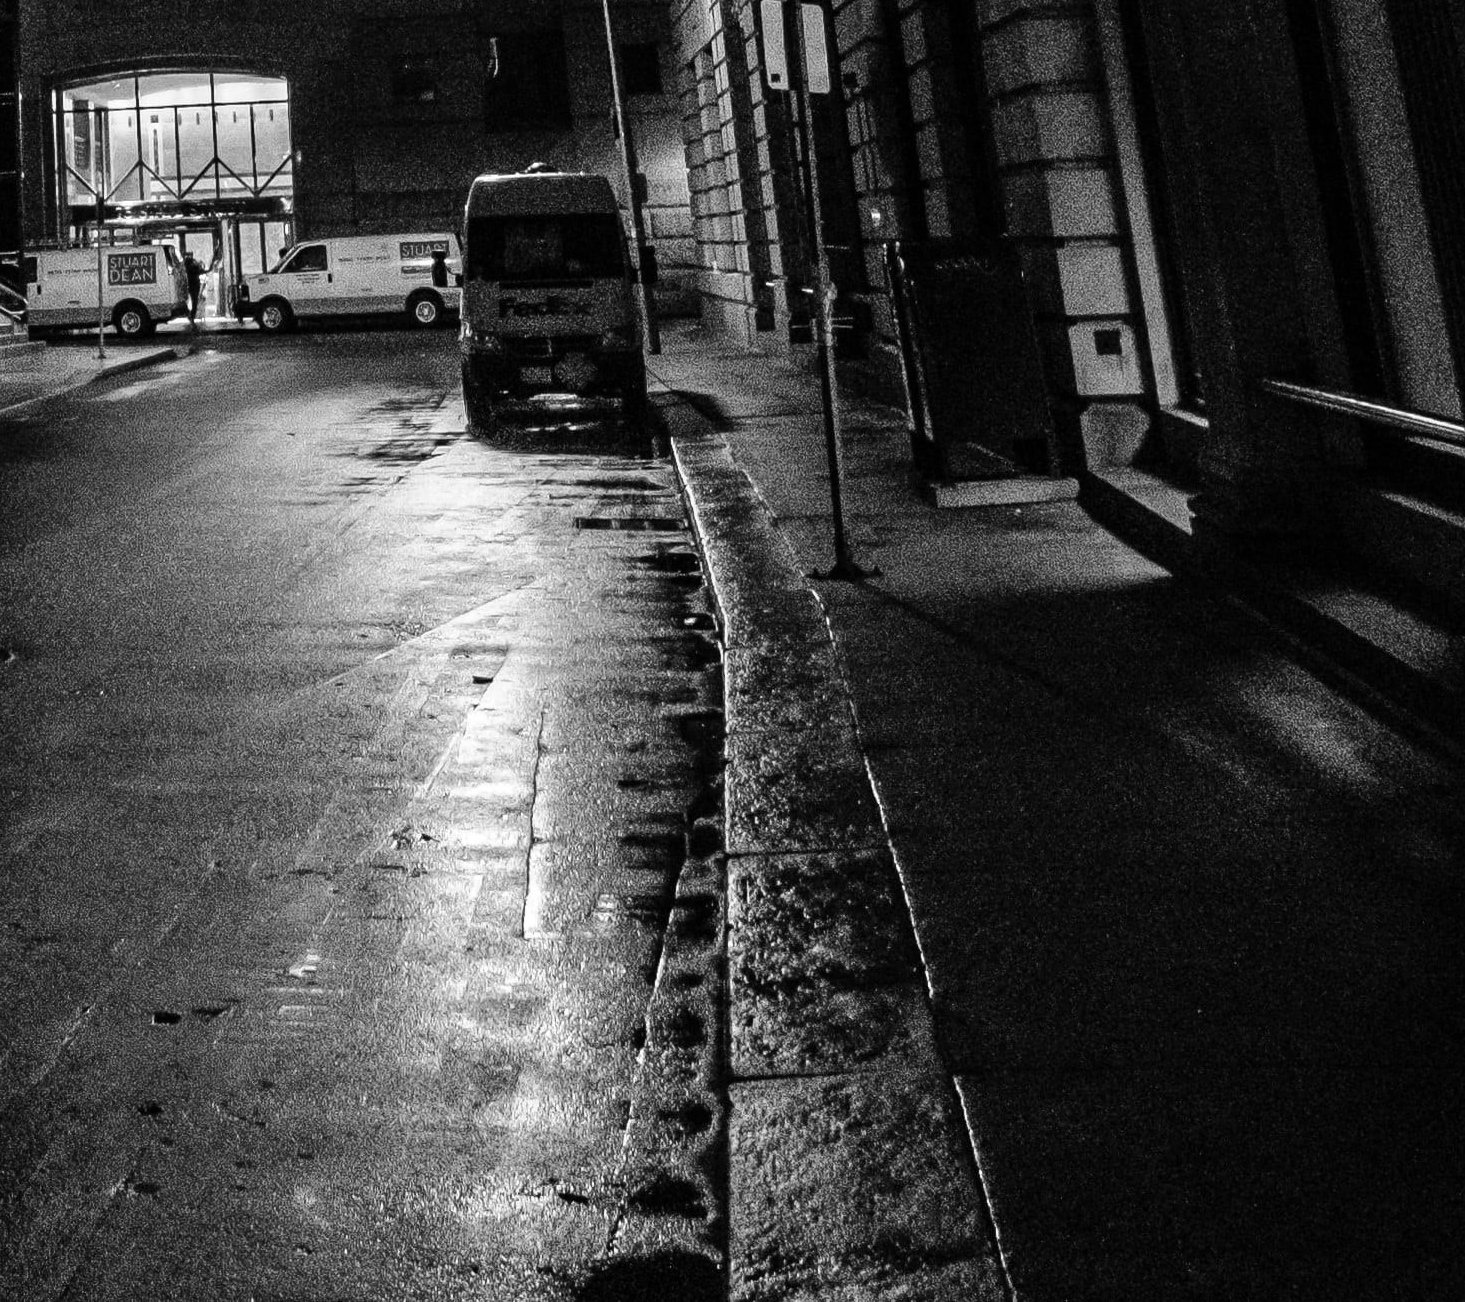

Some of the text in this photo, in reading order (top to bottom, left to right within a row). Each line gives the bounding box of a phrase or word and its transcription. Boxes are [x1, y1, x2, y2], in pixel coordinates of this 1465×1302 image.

[110, 255, 153, 269] STUART
[110, 268, 153, 283] DEAN
[499, 296, 592, 317] FedEx
